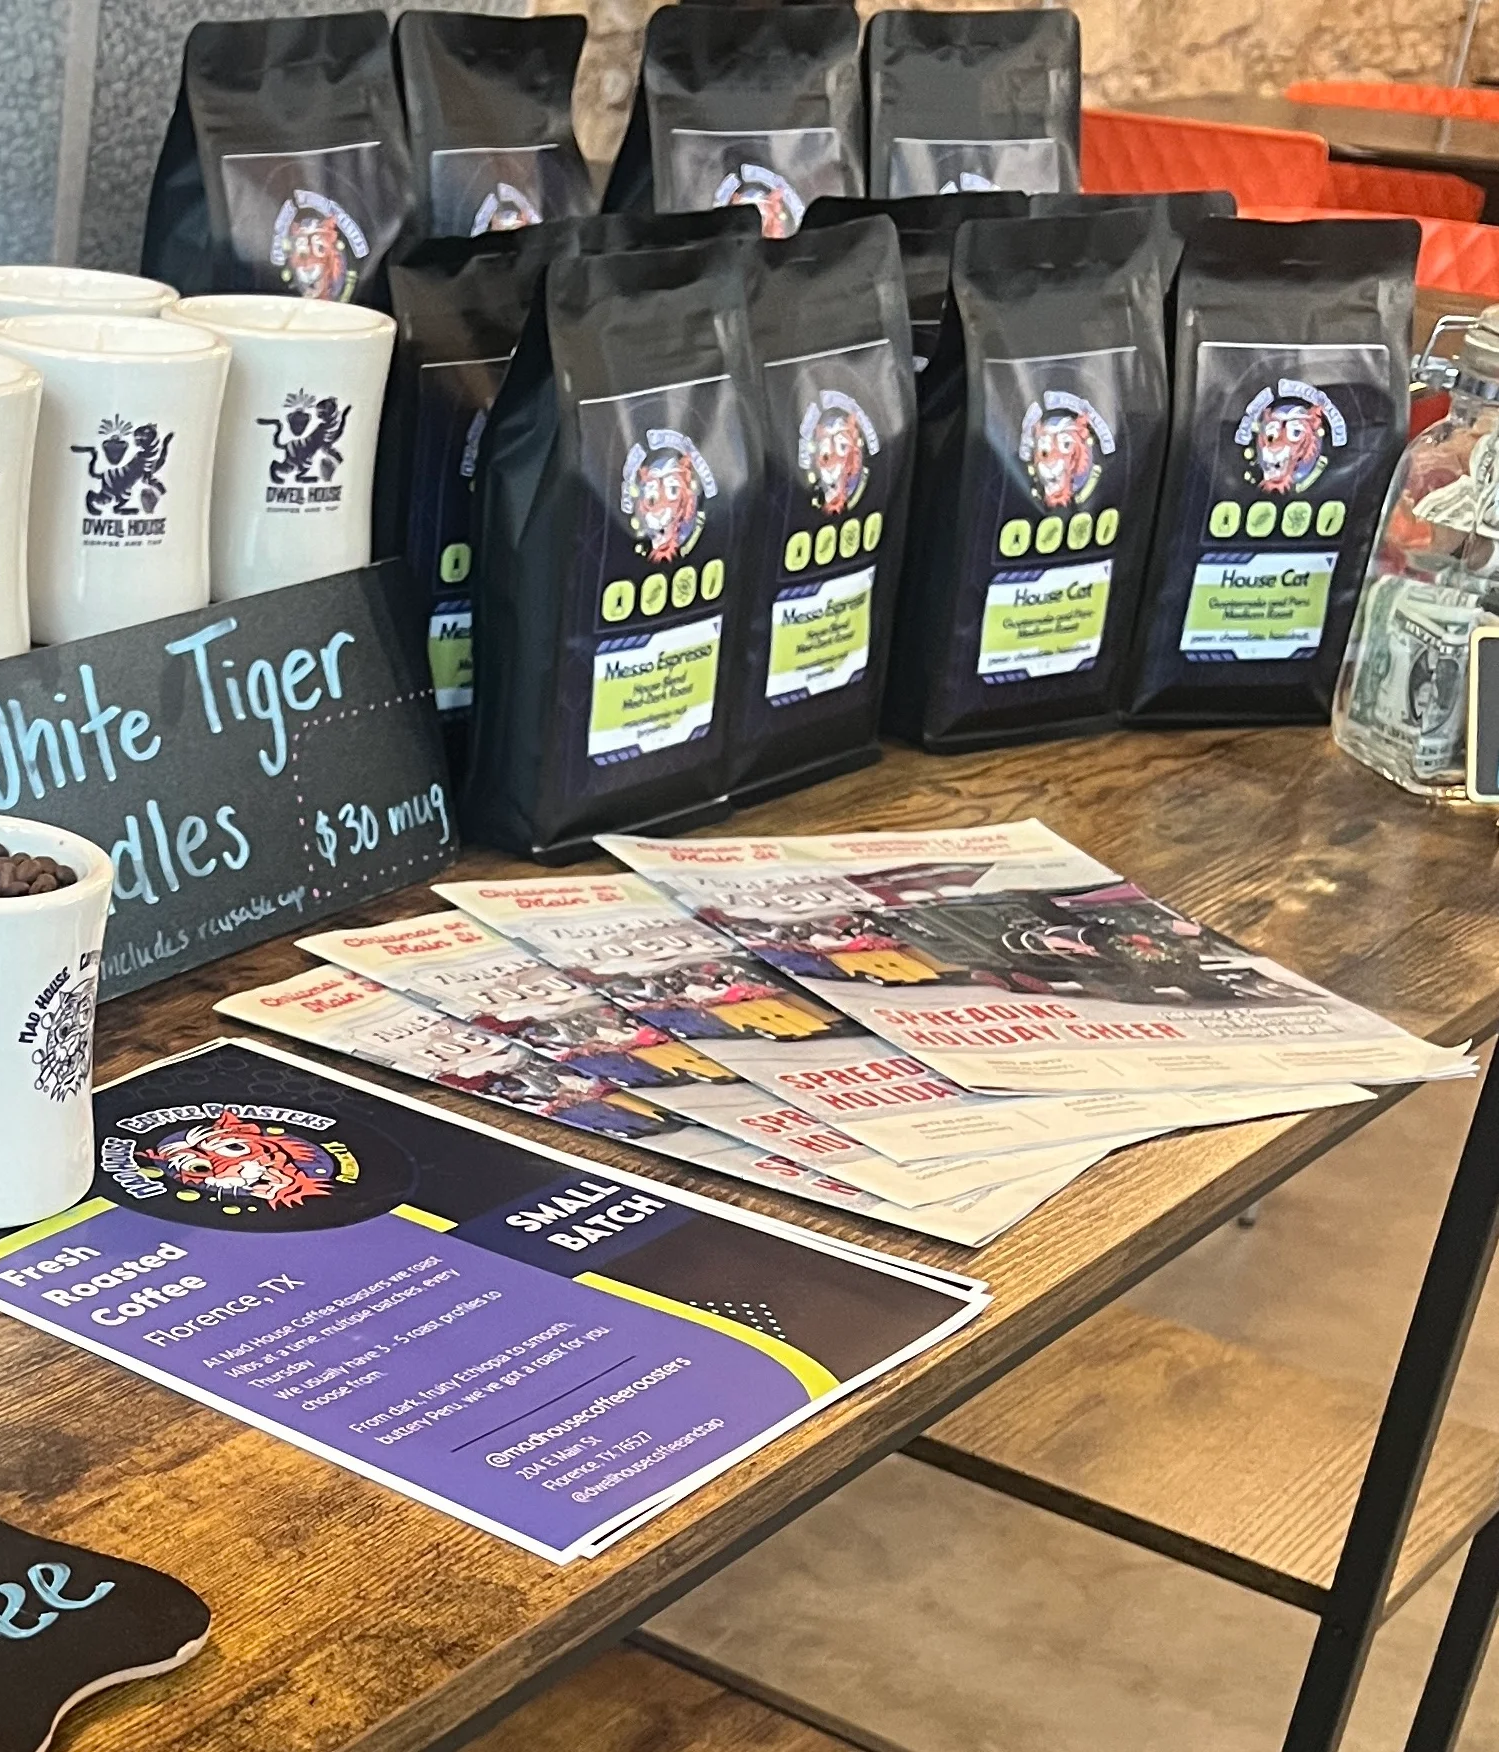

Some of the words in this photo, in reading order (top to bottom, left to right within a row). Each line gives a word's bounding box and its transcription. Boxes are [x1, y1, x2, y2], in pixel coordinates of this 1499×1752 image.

[82, 518, 124, 538] DWELL
[127, 517, 166, 536] HOUSE
[1014, 588, 1063, 607] House
[1066, 581, 1093, 600] Cat
[1220, 569, 1277, 588] House
[1281, 568, 1310, 588] Cat
[165, 617, 355, 777] Tiger
[314, 802, 379, 867] $30
[389, 783, 453, 844] mug
[108, 800, 251, 915] dles
[381, 939, 452, 956] Main
[18, 1012, 41, 1044] MAD
[34, 966, 71, 1011] HOUSE
[300, 991, 364, 1014] Main
[466, 976, 579, 1006] FOCU
[870, 1002, 1082, 1028] SPREADING
[901, 1023, 1067, 1049] HOLIDAY
[1065, 1019, 1192, 1042] CHEER
[777, 1054, 929, 1093] SPREAD
[201, 1102, 337, 1131] ROASTERS
[815, 1077, 961, 1115] HOLIDA
[116, 1105, 204, 1134] COFFEE
[100, 1137, 137, 1173] HOUSE
[112, 1167, 167, 1199] MAD
[506, 1180, 621, 1232] SMALL
[546, 1194, 667, 1251] BATCH
[40, 1242, 189, 1307] Roasted
[90, 1274, 208, 1327] Coffee
[143, 1291, 274, 1348] Florence,
[257, 1273, 306, 1295] TX
[202, 1358, 225, 1369] At
[222, 1341, 255, 1366] Mad
[251, 1324, 297, 1350] House
[291, 1302, 336, 1329] Coffee
[332, 1278, 393, 1309] Roasters
[388, 1270, 411, 1285] we
[407, 1255, 444, 1275] roast
[260, 1351, 280, 1365] at
[278, 1347, 290, 1357] a
[319, 1308, 375, 1338] multiple
[421, 1267, 461, 1291] every
[273, 1384, 297, 1401] We
[294, 1361, 351, 1393] usually
[346, 1349, 383, 1370] have
[373, 1343, 392, 1355] 3
[394, 1335, 411, 1345] 5
[405, 1318, 444, 1340] roast
[439, 1295, 490, 1325] profiles
[484, 1289, 503, 1303] to
[247, 1358, 316, 1390] Thursday
[349, 1412, 393, 1434] From
[417, 1377, 462, 1400] fruity
[453, 1351, 513, 1383] Ethiopia
[506, 1344, 527, 1358] to
[374, 1415, 434, 1446] buttery
[499, 1369, 528, 1388] got
[523, 1364, 537, 1374] a
[530, 1346, 570, 1370] roast
[560, 1336, 587, 1352] for
[301, 1384, 353, 1412] choose
[485, 1356, 692, 1468] @madhousecoffeeroasters
[515, 1463, 547, 1481] 204
[542, 1456, 559, 1468] E
[552, 1442, 588, 1463] Main
[583, 1435, 603, 1448] St
[571, 1416, 725, 1504] @dwellhousecoffeeandtap
[596, 1450, 619, 1462] TX
[614, 1430, 653, 1455] 76527
